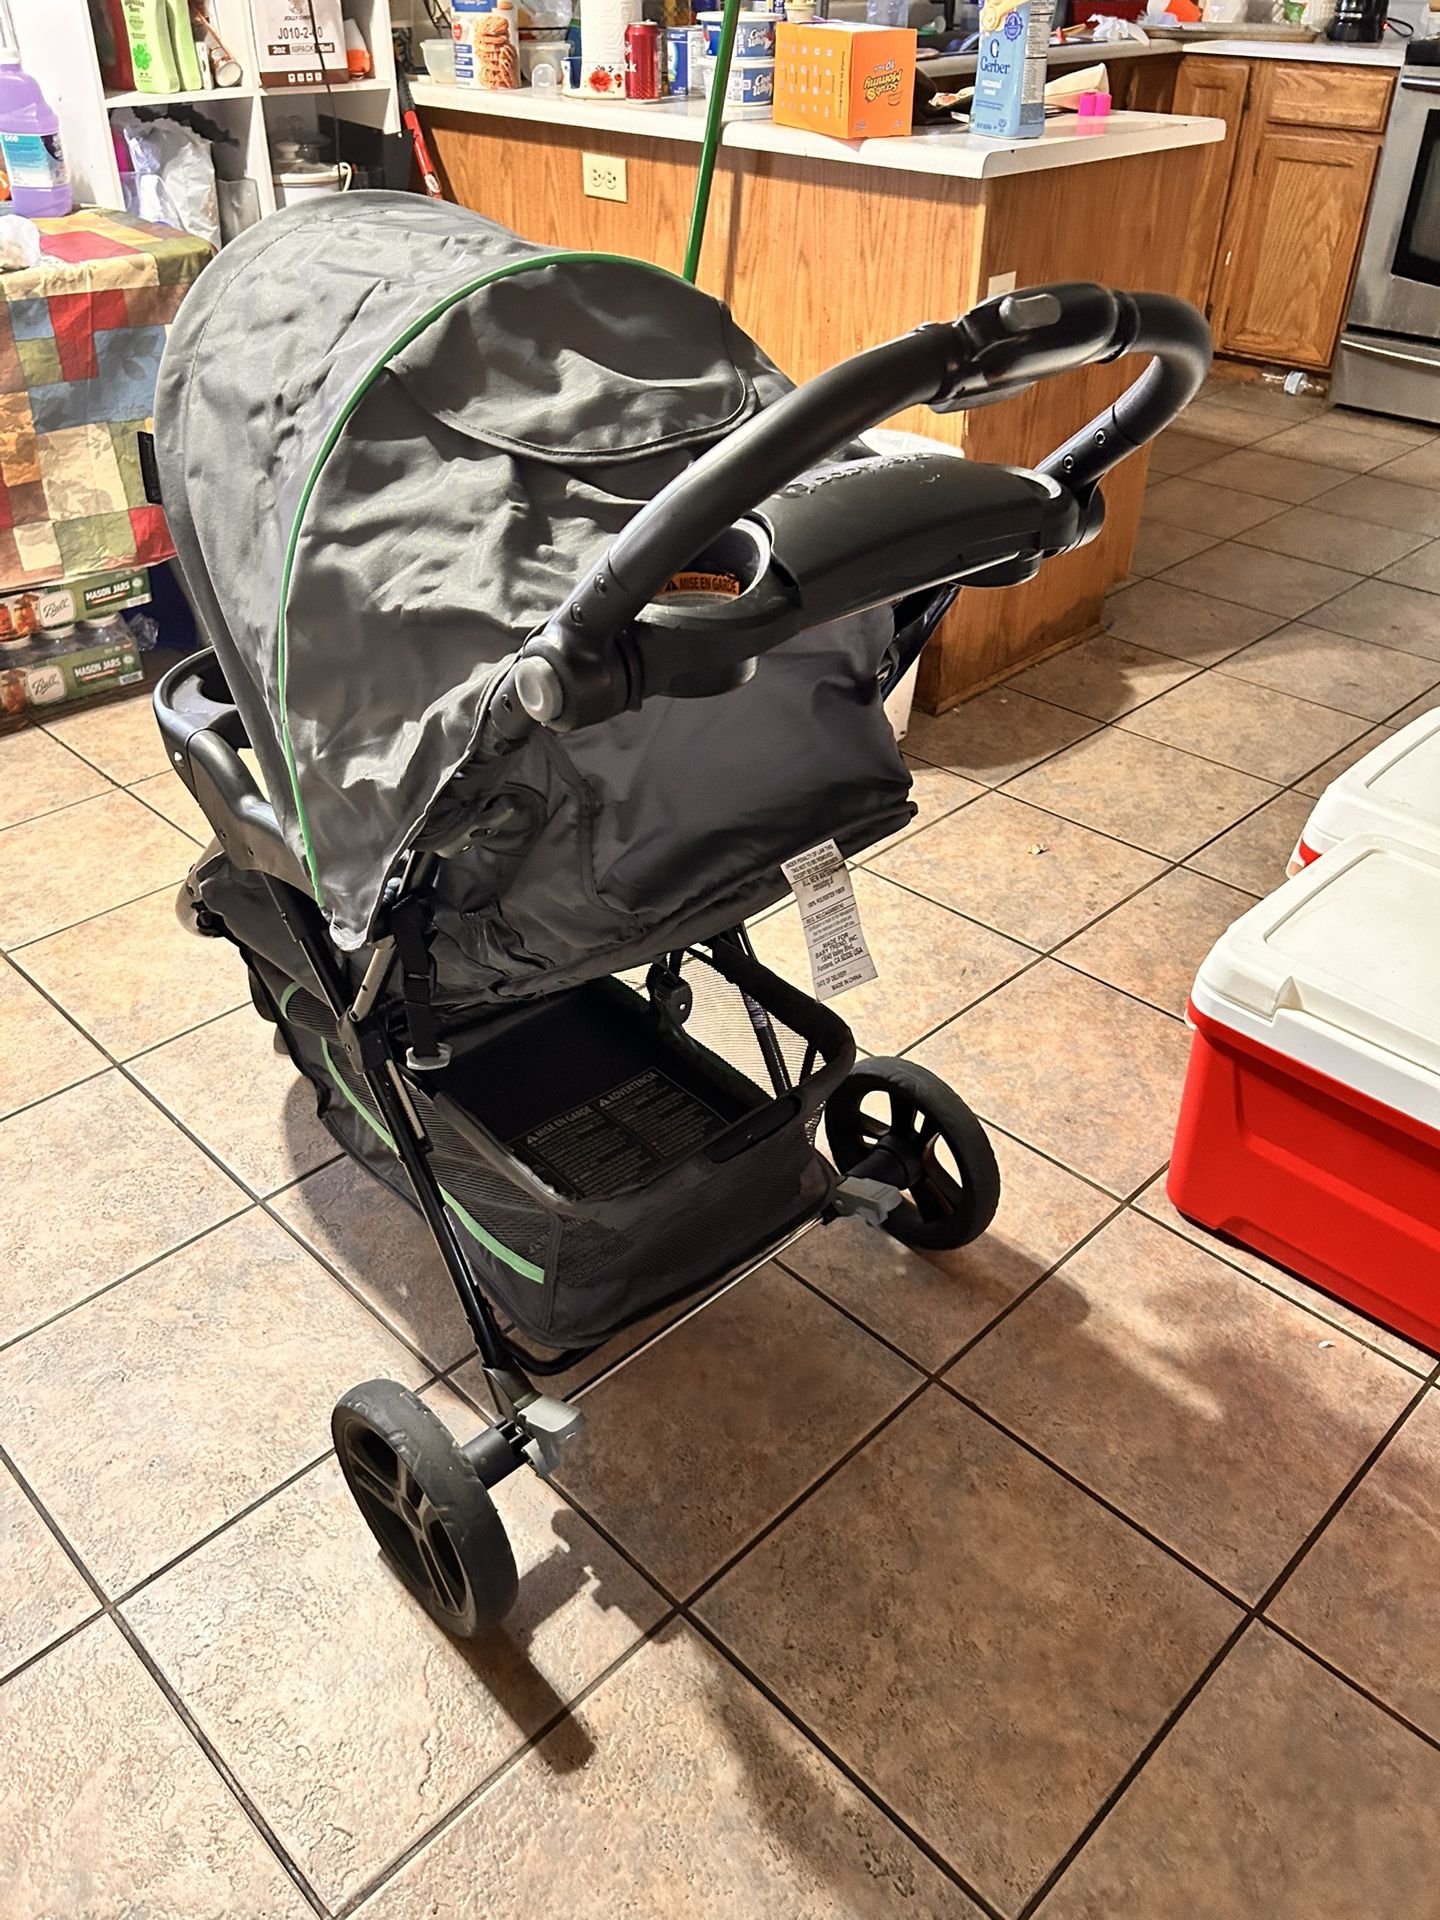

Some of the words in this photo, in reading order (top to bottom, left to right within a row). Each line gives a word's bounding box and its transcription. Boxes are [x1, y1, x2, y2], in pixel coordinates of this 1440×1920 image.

[278, 26, 323, 40] J010-2-0
[981, 56, 1010, 75] Gerber
[85, 585, 111, 601] MASON
[113, 581, 130, 594] JARS
[679, 577, 699, 590] MISE
[700, 579, 711, 590] EN
[712, 578, 737, 593] GARDE
[43, 598, 70, 618] Ball
[74, 662, 101, 677] MASON
[103, 657, 121, 670] JARS
[32, 674, 59, 695] Ball
[838, 932, 848, 942] FOR
[815, 948, 829, 959] BABY
